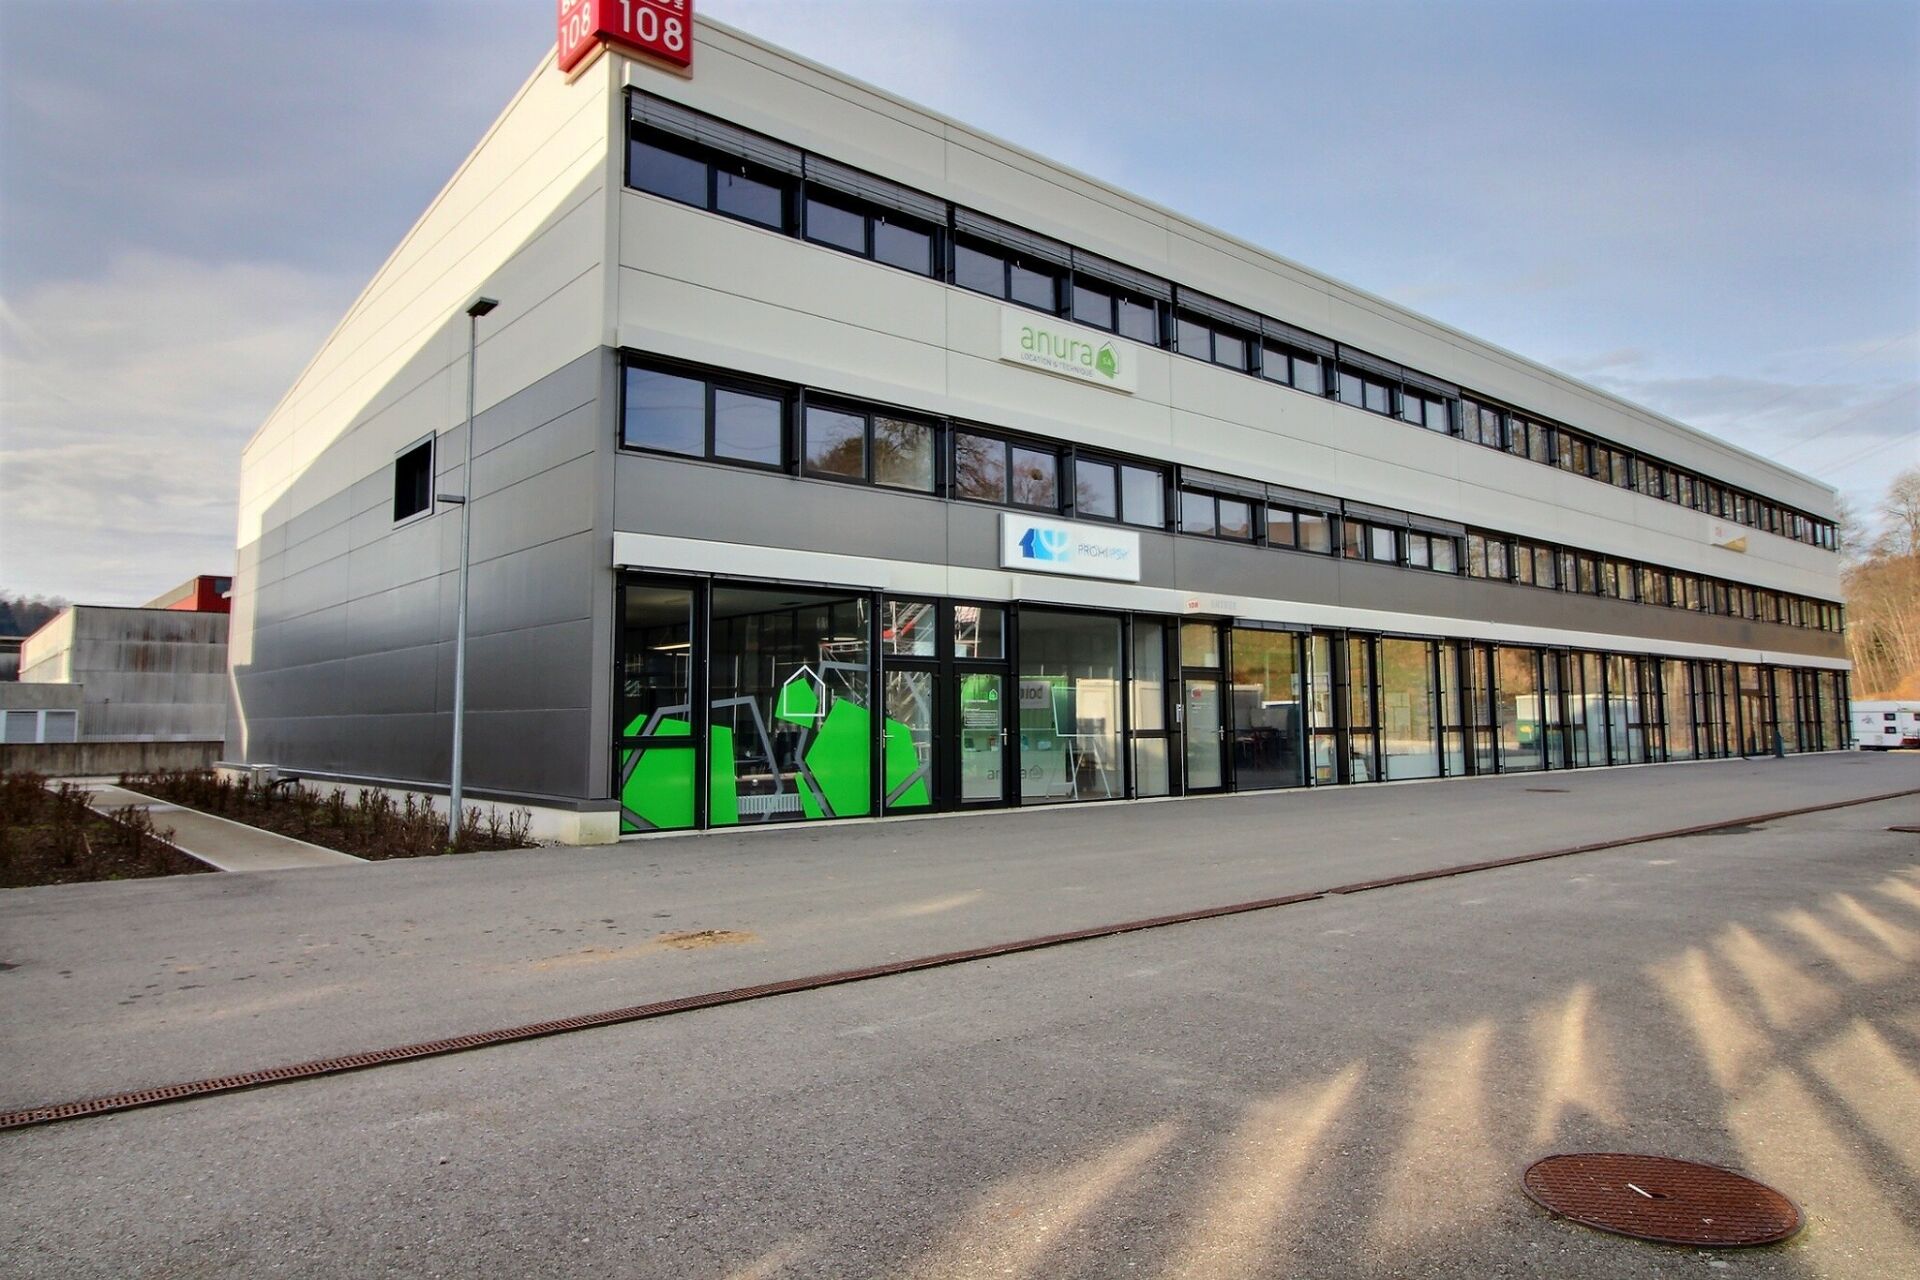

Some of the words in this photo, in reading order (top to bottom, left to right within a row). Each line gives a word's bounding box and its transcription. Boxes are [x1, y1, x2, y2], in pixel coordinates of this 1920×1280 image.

[561, 1, 591, 57] 108
[619, 0, 684, 52] 108
[1020, 327, 1092, 366] anura
